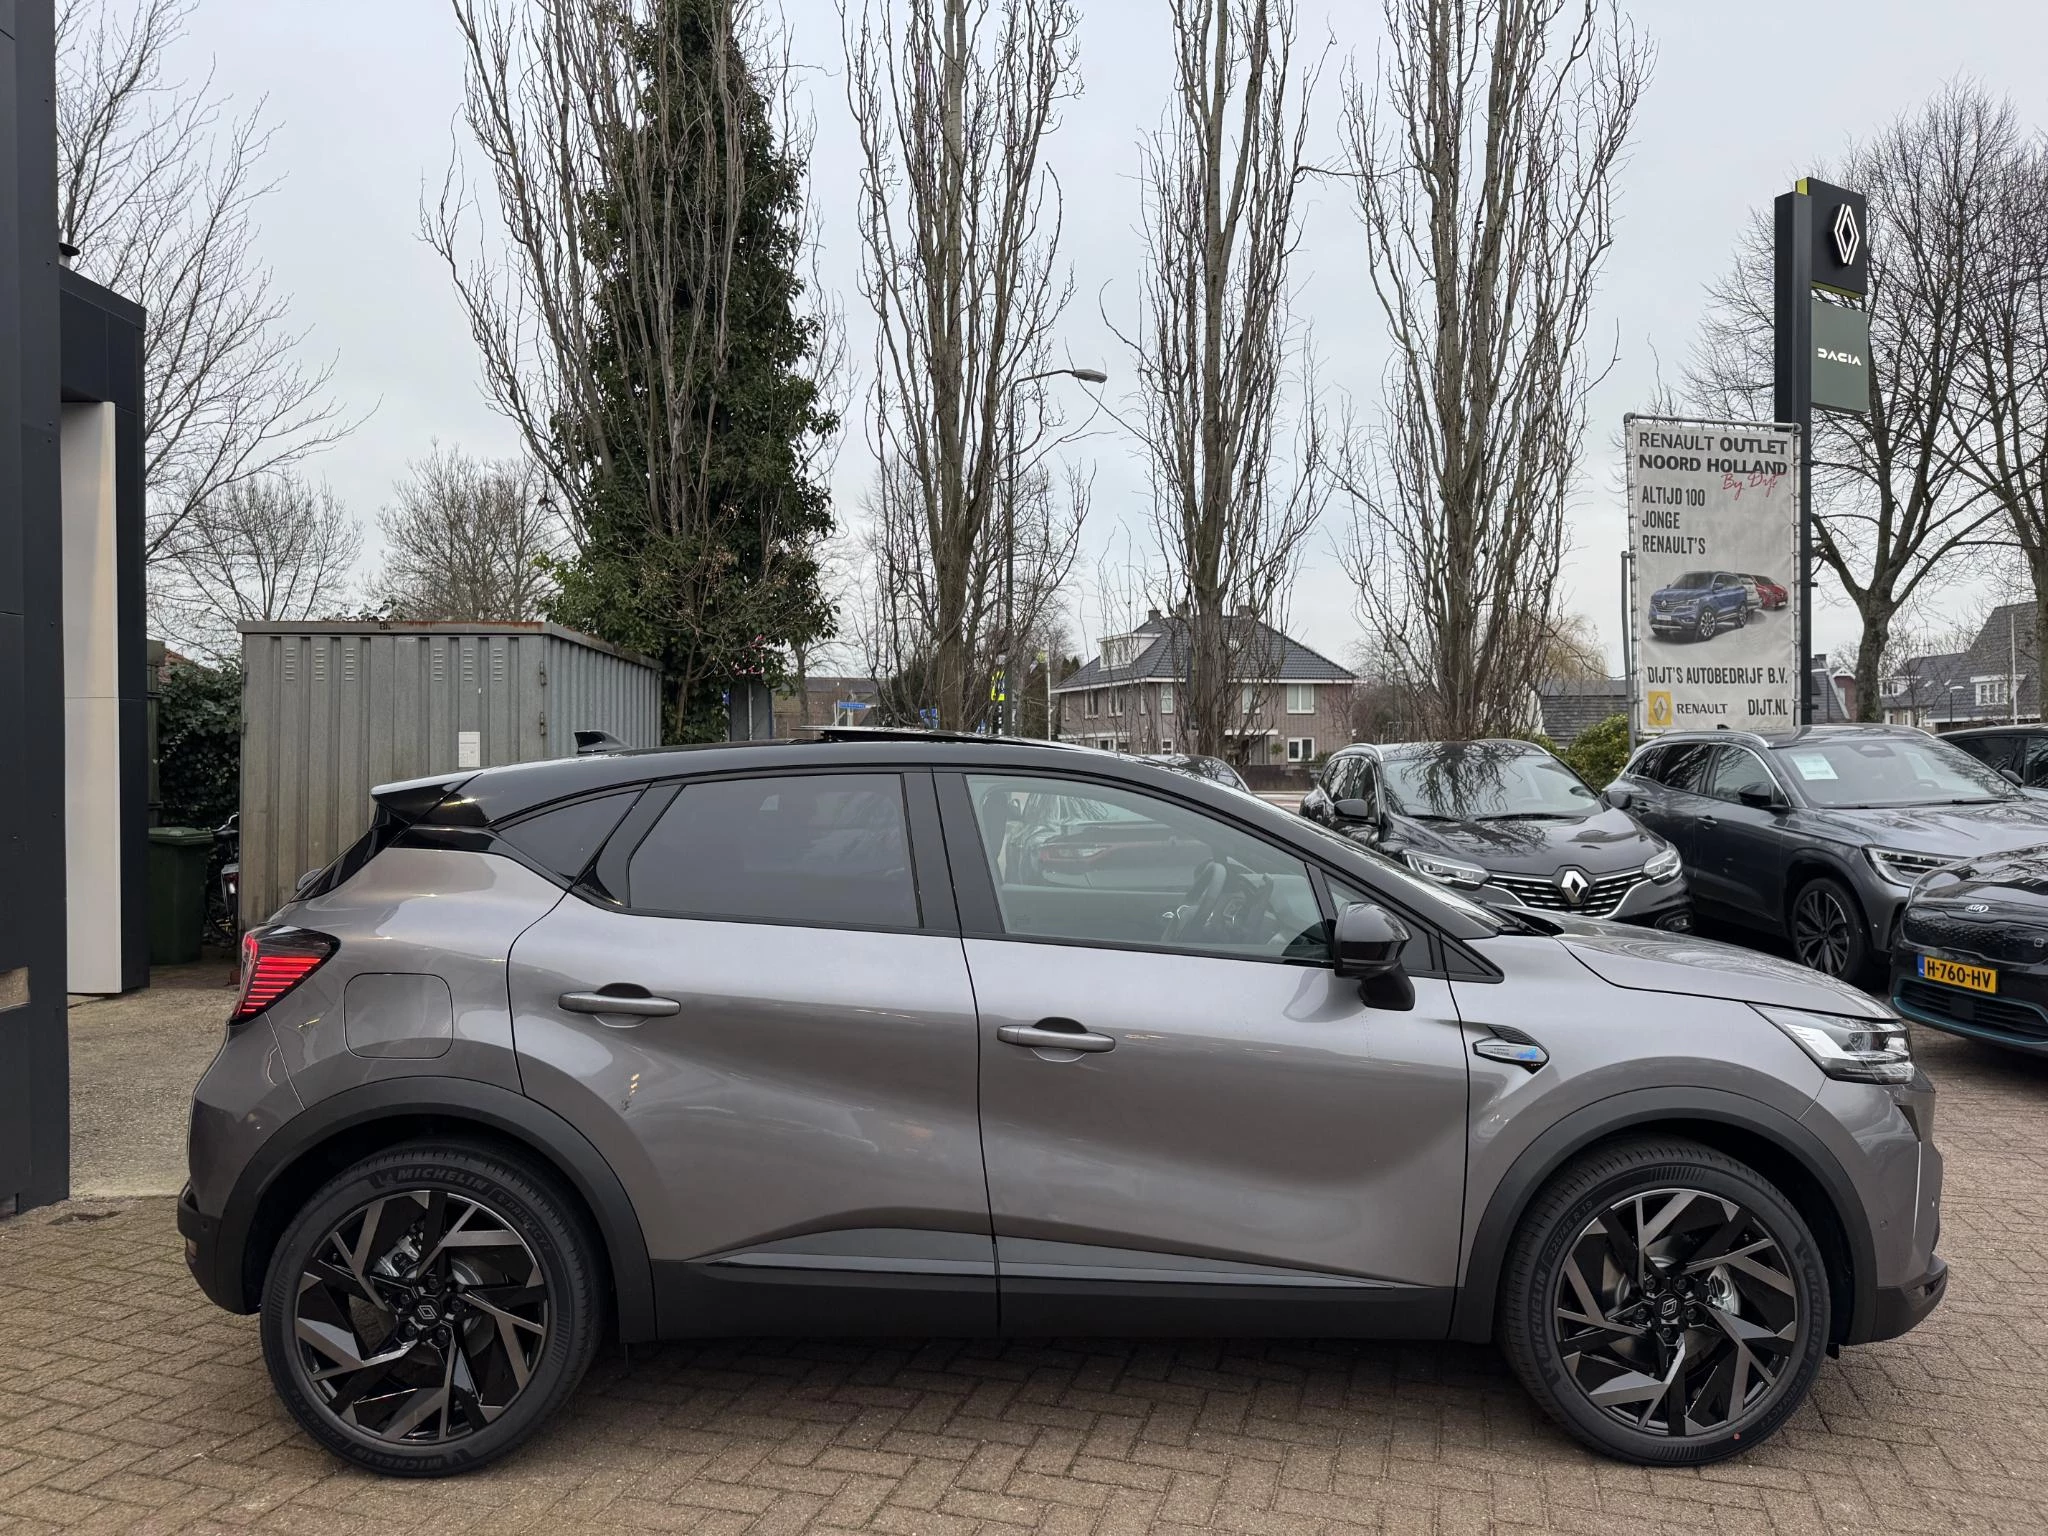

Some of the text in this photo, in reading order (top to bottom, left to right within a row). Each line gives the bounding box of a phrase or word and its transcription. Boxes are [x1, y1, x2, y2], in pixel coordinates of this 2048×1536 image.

[1817, 347, 1862, 366] DACIA
[1639, 432, 1788, 455] RENAULT OUTLET
[1639, 454, 1787, 475] NOORD HOLLAND
[1642, 485, 1705, 506] ALTIJD 100
[1721, 473, 1744, 500] By
[1642, 510, 1680, 529] JONGE
[1642, 535, 1706, 555] RENAULT'S
[1648, 666, 1788, 685] DIJT'S AUTOBEDRIJF B.V.
[1677, 699, 1788, 715] RENAULT DIJT.NL
[1927, 960, 1991, 988] H-760-HV
[396, 1168, 488, 1192] MICHELIN
[1530, 1267, 1549, 1360] MICHELIN
